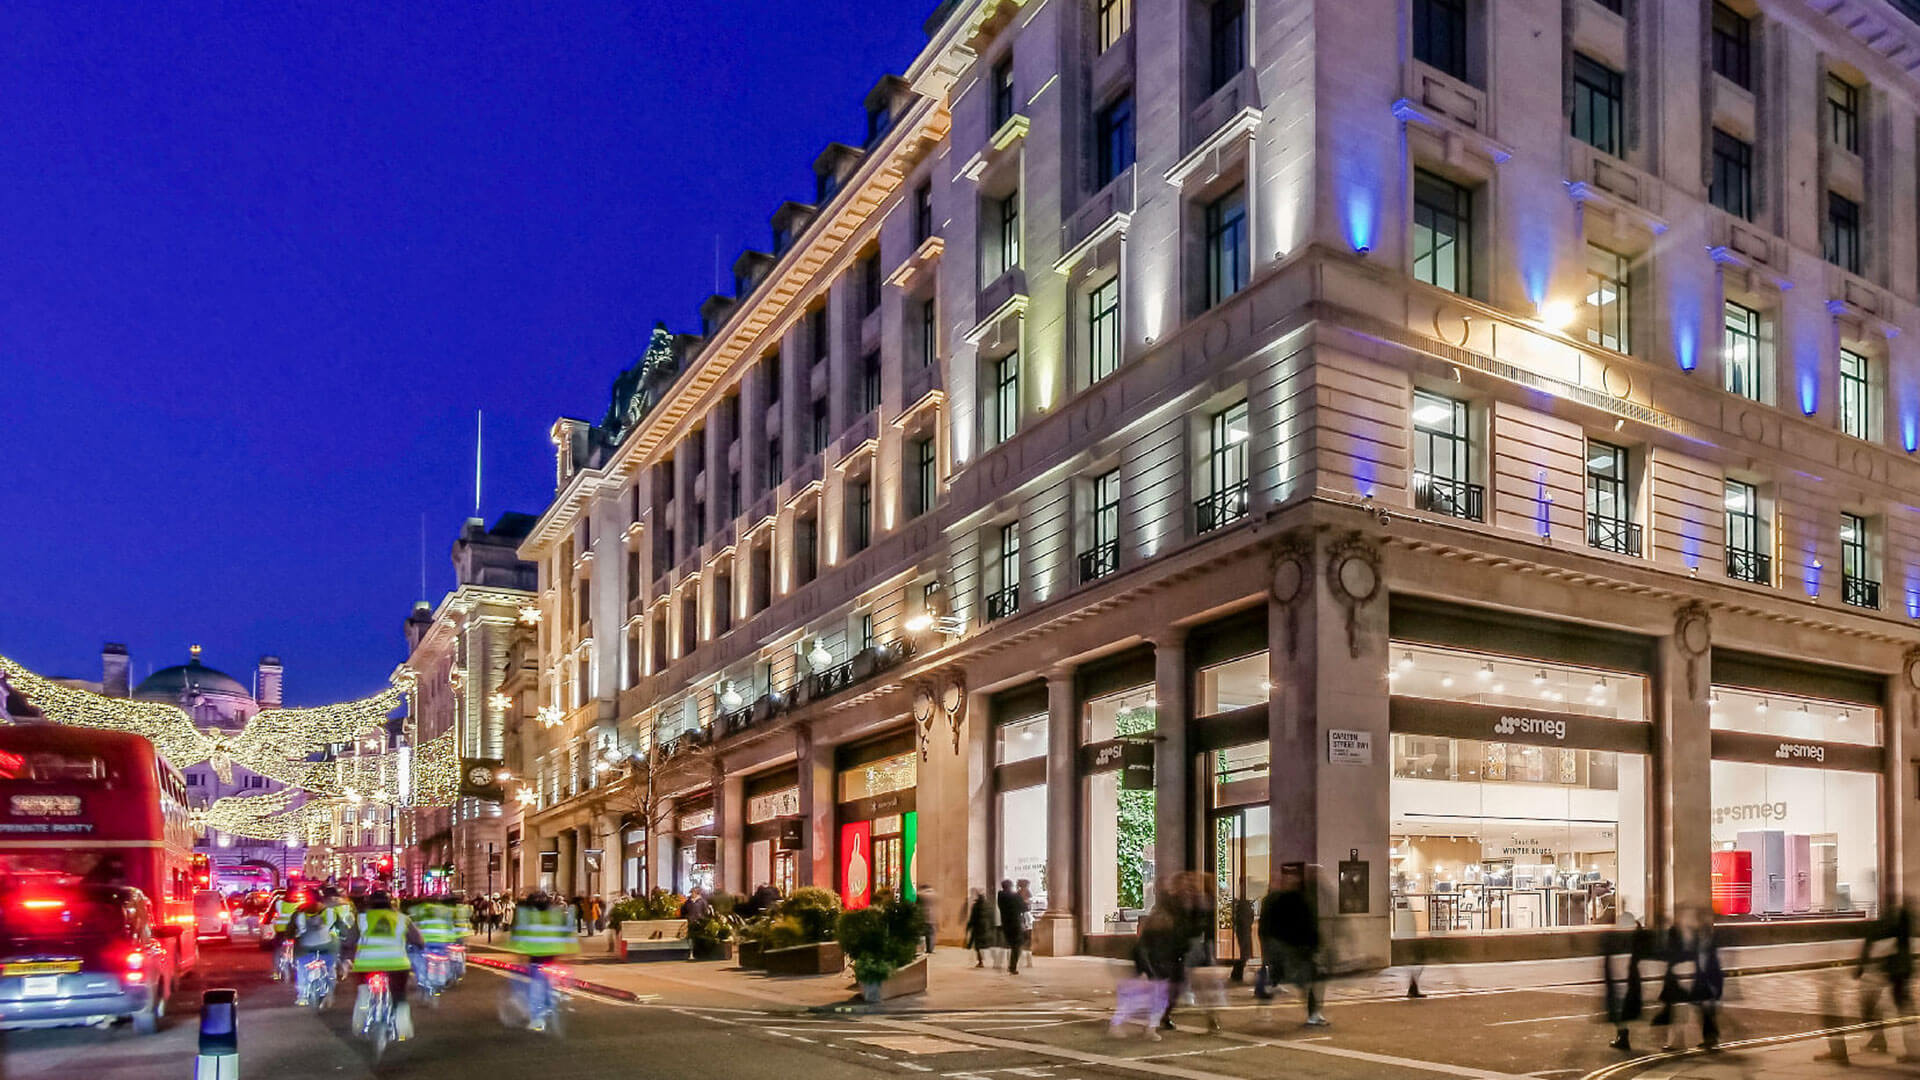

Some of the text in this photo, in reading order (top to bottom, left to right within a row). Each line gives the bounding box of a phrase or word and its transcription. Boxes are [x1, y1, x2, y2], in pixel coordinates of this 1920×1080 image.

[1521, 718, 1566, 739] smeg
[1333, 741, 1355, 749] STREET
[1793, 744, 1825, 761] smeg
[1731, 801, 1787, 821] smeg
[52, 823, 93, 832] PARTY
[1502, 847, 1553, 856] WINTER BLUES
